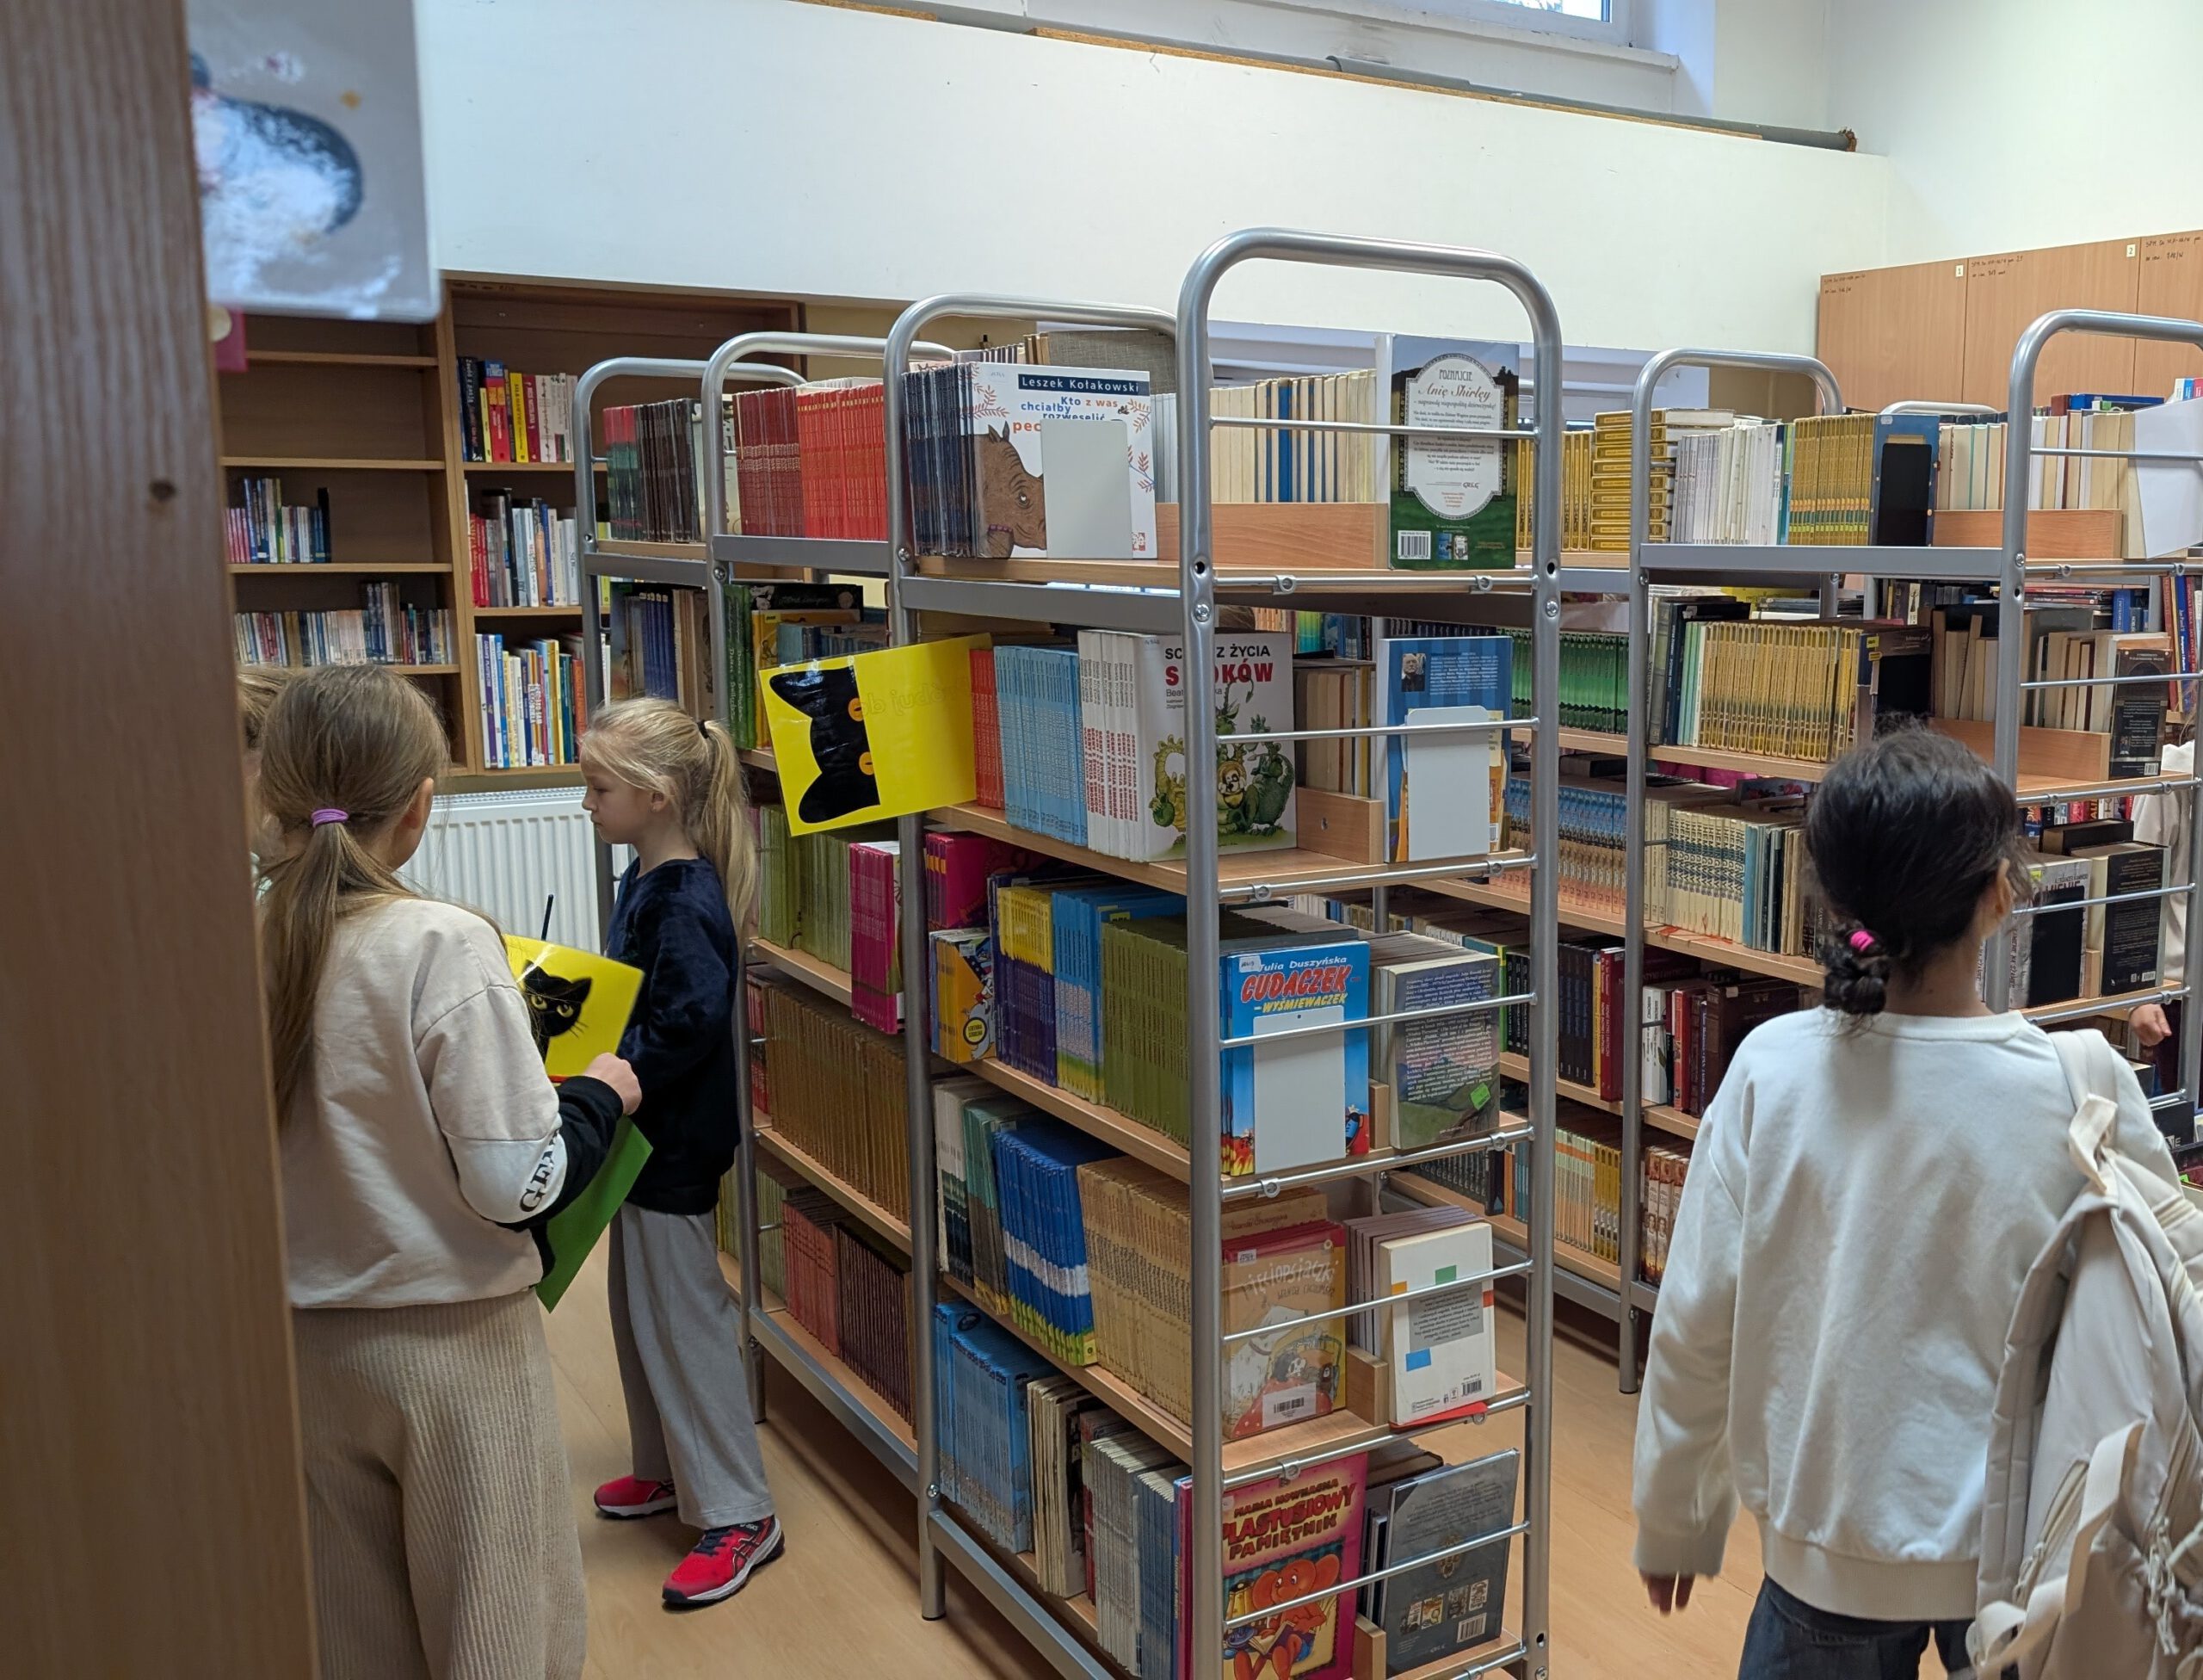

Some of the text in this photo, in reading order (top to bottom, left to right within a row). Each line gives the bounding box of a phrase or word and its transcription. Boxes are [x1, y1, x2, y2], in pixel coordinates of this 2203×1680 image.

[1021, 376, 1140, 393] Leszek Kołakowski
[1451, 384, 1491, 403] Shirley
[1021, 402, 1071, 414] chciałby
[1061, 396, 1082, 406] Kto
[1013, 420, 1042, 434] pec
[1216, 644, 1271, 658] Z ŻYCIA
[1165, 658, 1274, 686] SKÓW
[1166, 689, 1184, 697] Beat
[1289, 955, 1348, 969] Duszyńska
[1234, 1498, 1273, 1519] MARIA
[1229, 1512, 1337, 1560] PAMIĘTNIK
